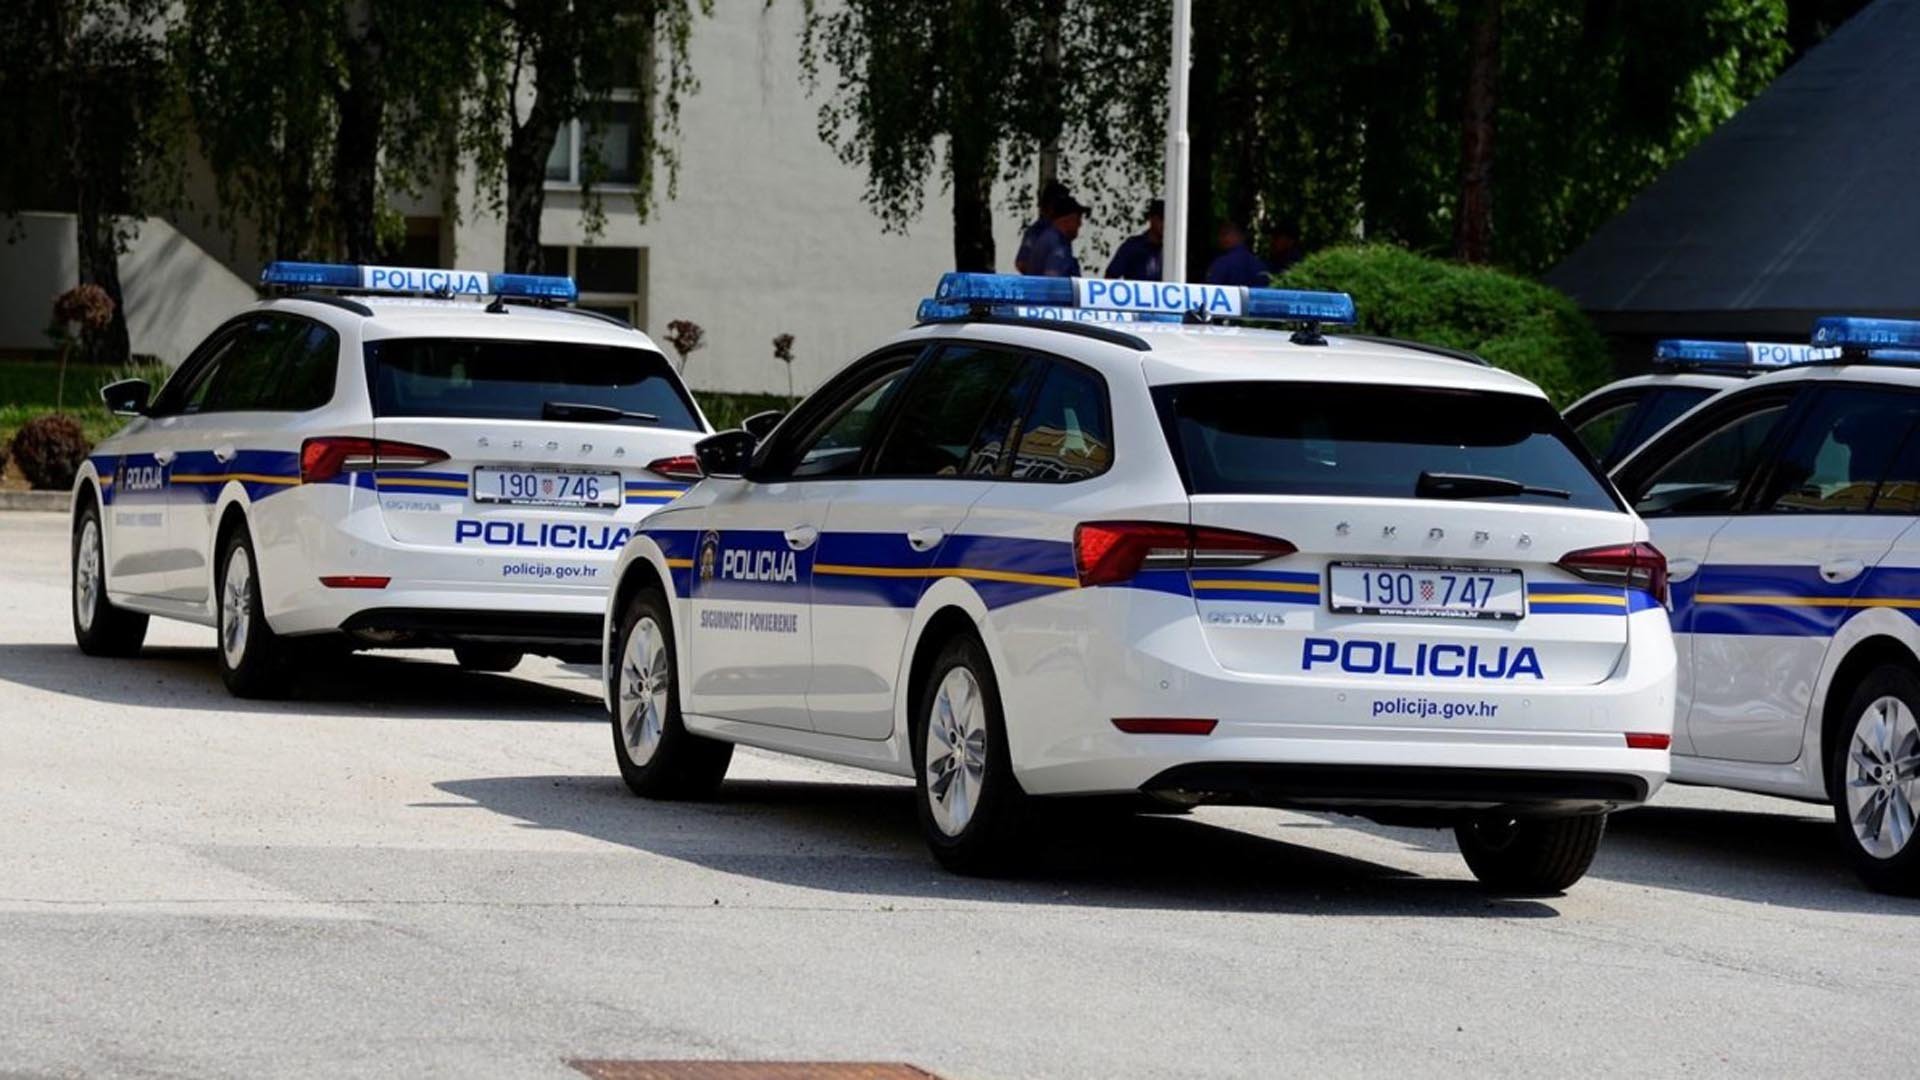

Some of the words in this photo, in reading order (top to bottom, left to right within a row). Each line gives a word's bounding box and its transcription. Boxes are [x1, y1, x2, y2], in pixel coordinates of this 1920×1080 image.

[372, 269, 482, 294] POLICIJA
[1088, 280, 1232, 313] POLICIJA
[499, 473, 538, 498] 190
[556, 475, 600, 501] 746
[455, 519, 630, 551] POLICIJA
[503, 562, 598, 578] policija.gov.hr
[721, 549, 798, 583] POLICIJA
[1362, 572, 1414, 605] 190
[1440, 575, 1495, 609] 747
[1301, 637, 1545, 680] POLICIJA
[1372, 697, 1499, 719] policija.gov.hr
